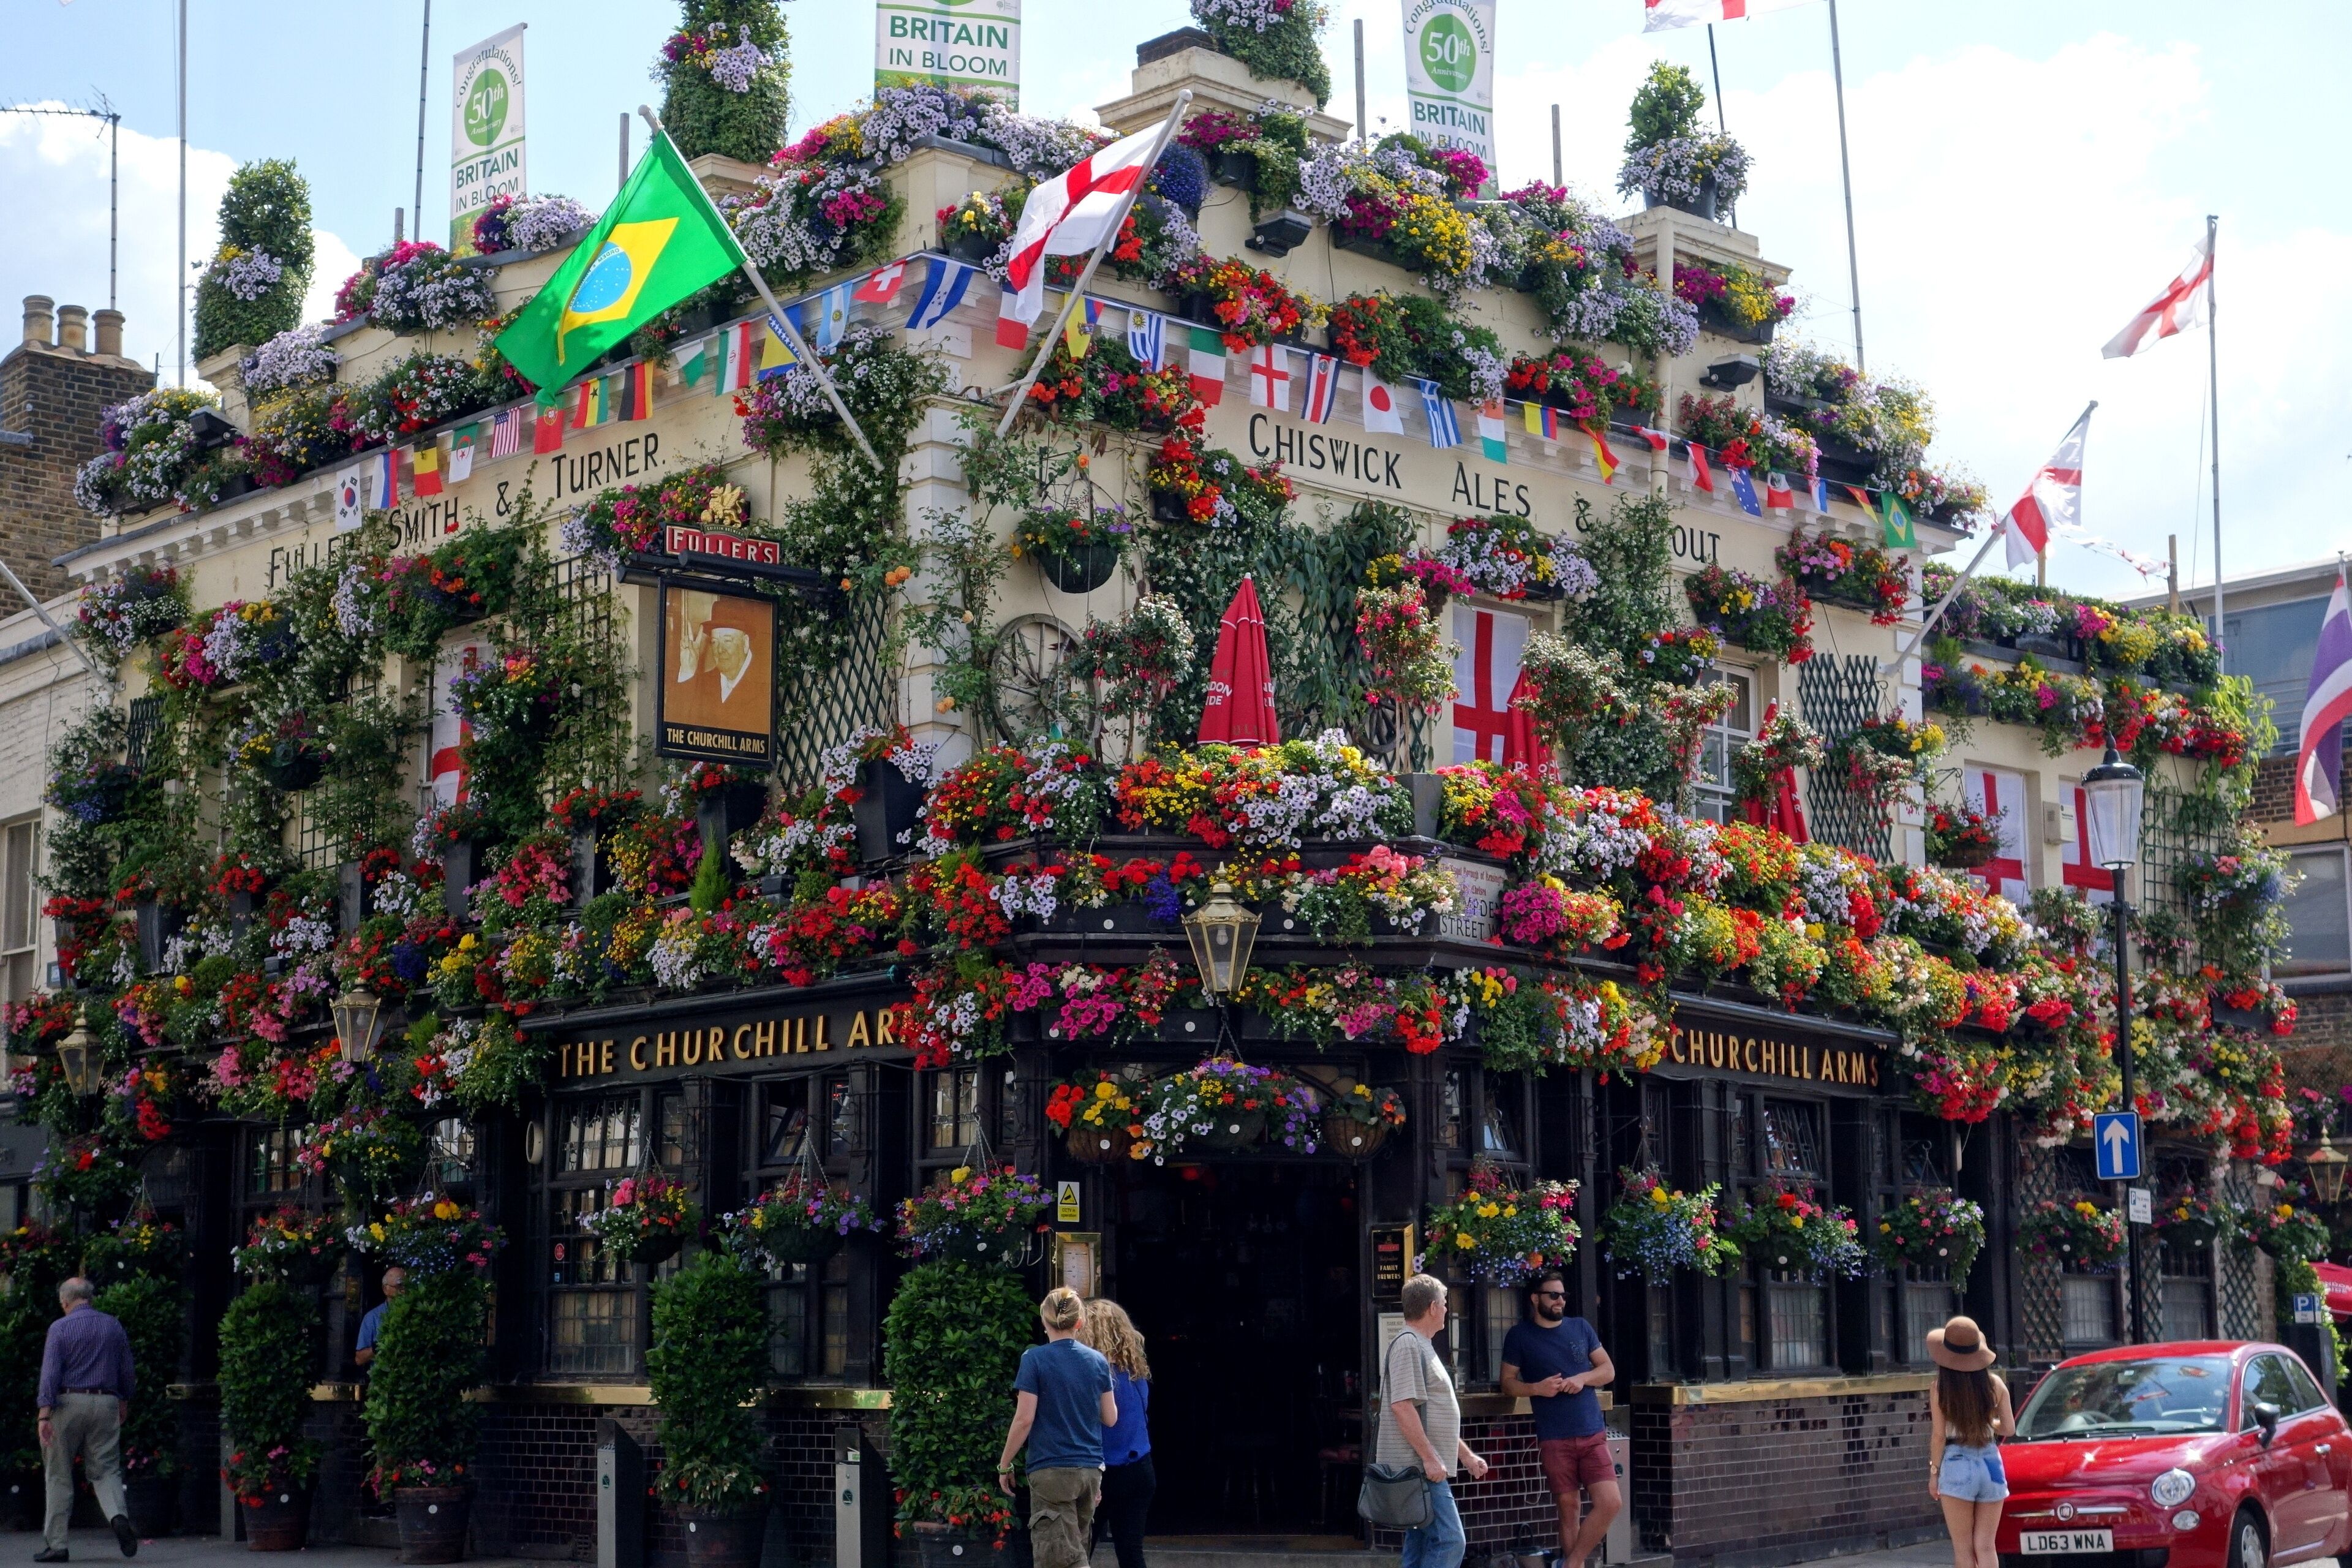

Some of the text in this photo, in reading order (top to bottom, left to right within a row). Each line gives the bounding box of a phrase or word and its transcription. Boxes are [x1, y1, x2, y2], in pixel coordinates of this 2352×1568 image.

[890, 15, 1008, 50] BRITAIN
[1426, 32, 1471, 64] 50th
[456, 45, 522, 108] Congratulations!
[889, 48, 1006, 77] IN BLOOM
[468, 83, 504, 124] 50th
[1414, 100, 1485, 136] BRITAIN
[1438, 134, 1487, 159] BLOOM
[456, 148, 518, 189] BRITAIN
[456, 176, 518, 213] IN BLOOM
[1250, 413, 1722, 564] CHISWICK ALES & OUT
[388, 497, 459, 549] SMITH
[496, 481, 512, 516] &
[674, 529, 774, 564] FULLER'S
[1205, 695, 1223, 706] IDE
[666, 728, 765, 754] THE CHURCHILL ARMS
[1441, 916, 1485, 940] STREET
[558, 1008, 905, 1078] THE CHURCHILL AR
[1671, 1029, 1879, 1087] CHURCHILL ARMS
[2297, 1296, 2309, 1311] P
[2027, 1533, 2105, 1551] LD63 WNA
